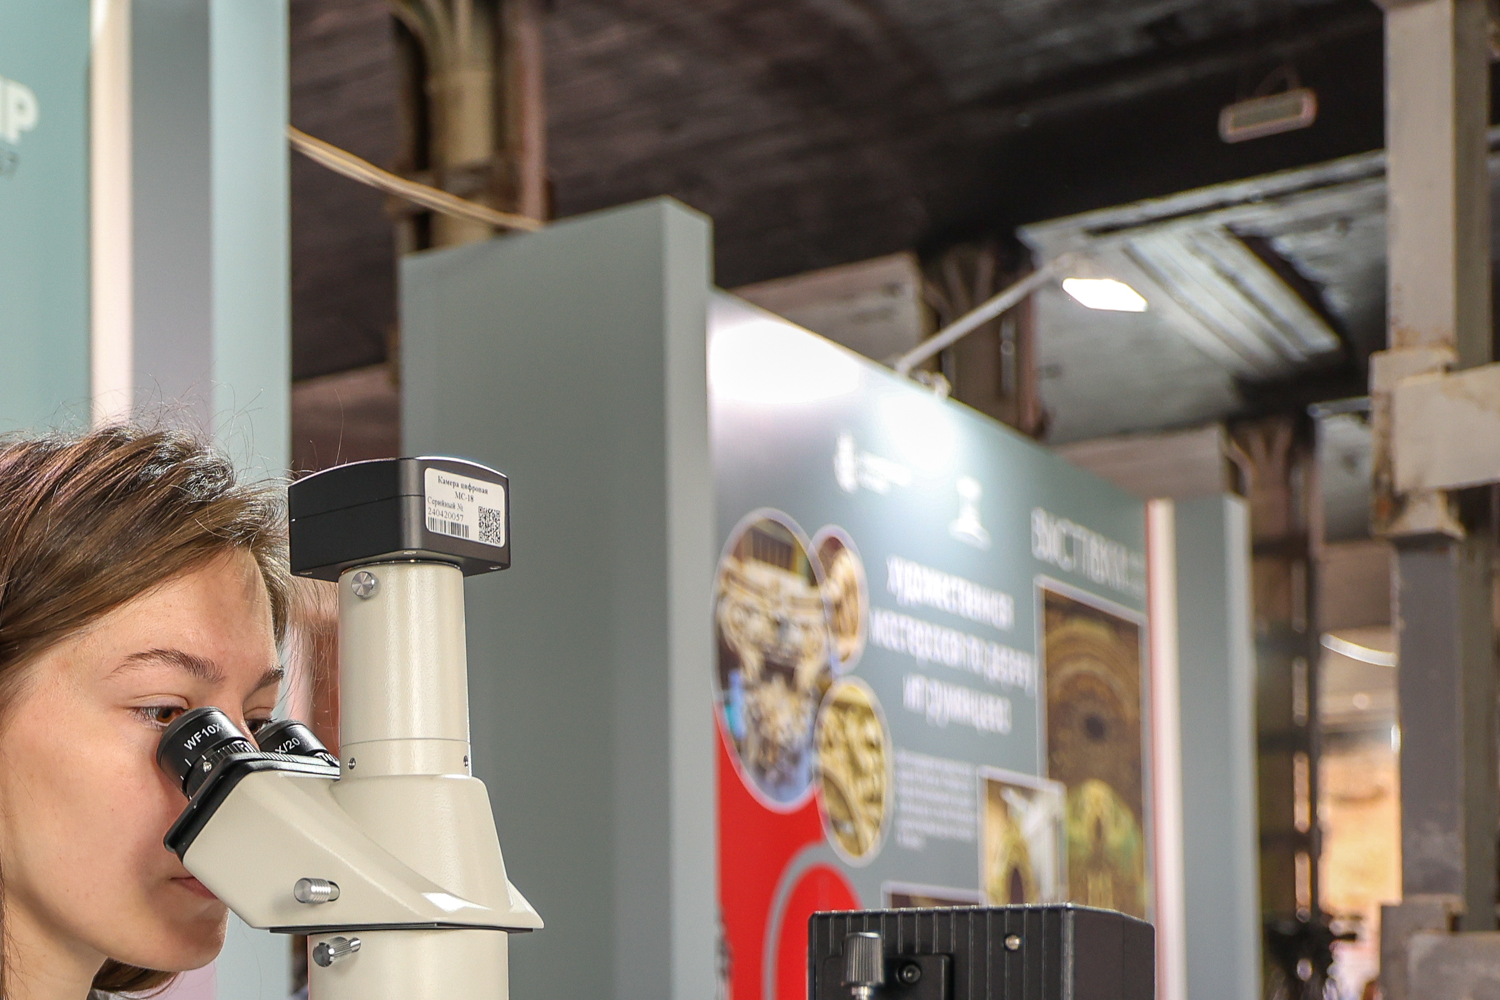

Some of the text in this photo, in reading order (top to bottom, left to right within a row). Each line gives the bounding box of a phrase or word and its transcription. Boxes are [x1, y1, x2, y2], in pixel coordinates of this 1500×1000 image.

[437, 475, 488, 495] Камера цифровая
[427, 496, 455, 509] Серийный
[428, 507, 464, 522] 240420057
[184, 722, 223, 751] WF10X
